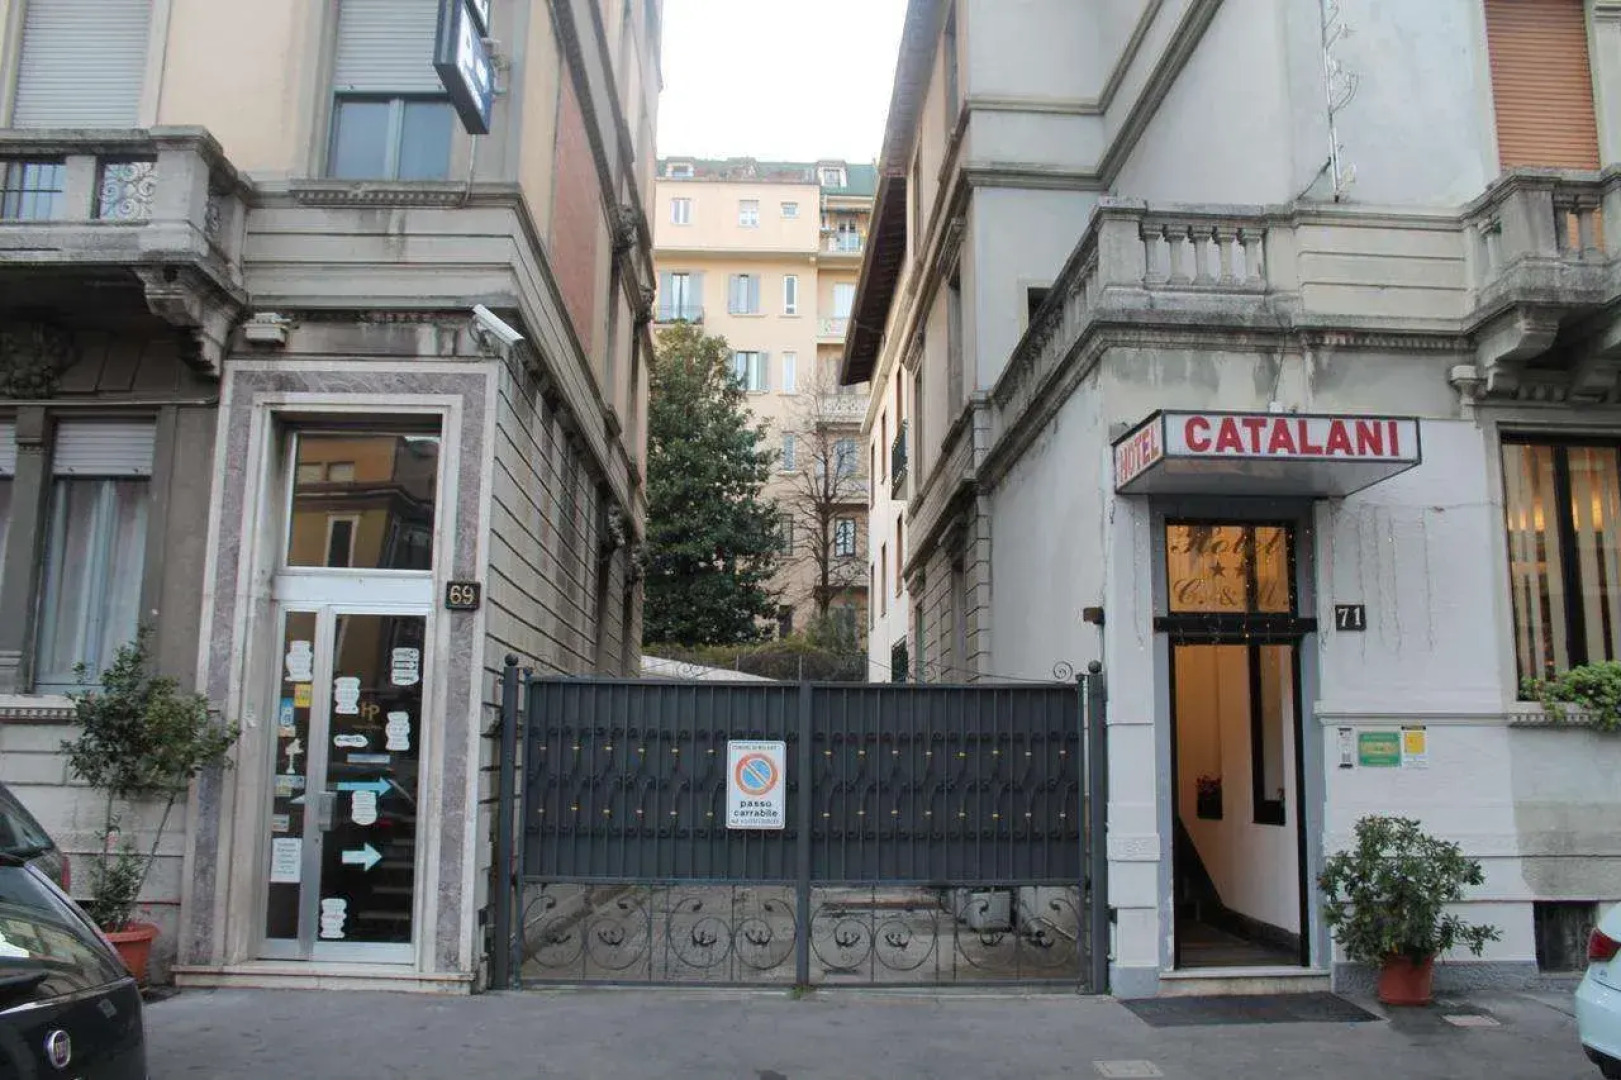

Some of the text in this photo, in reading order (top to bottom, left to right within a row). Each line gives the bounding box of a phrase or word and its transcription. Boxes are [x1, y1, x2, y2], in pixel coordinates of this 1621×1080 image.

[1118, 416, 1400, 483] HOTEL CATALANI
[450, 585, 474, 605] 69
[1336, 607, 1361, 628] 71
[734, 809, 778, 817] carrabile
